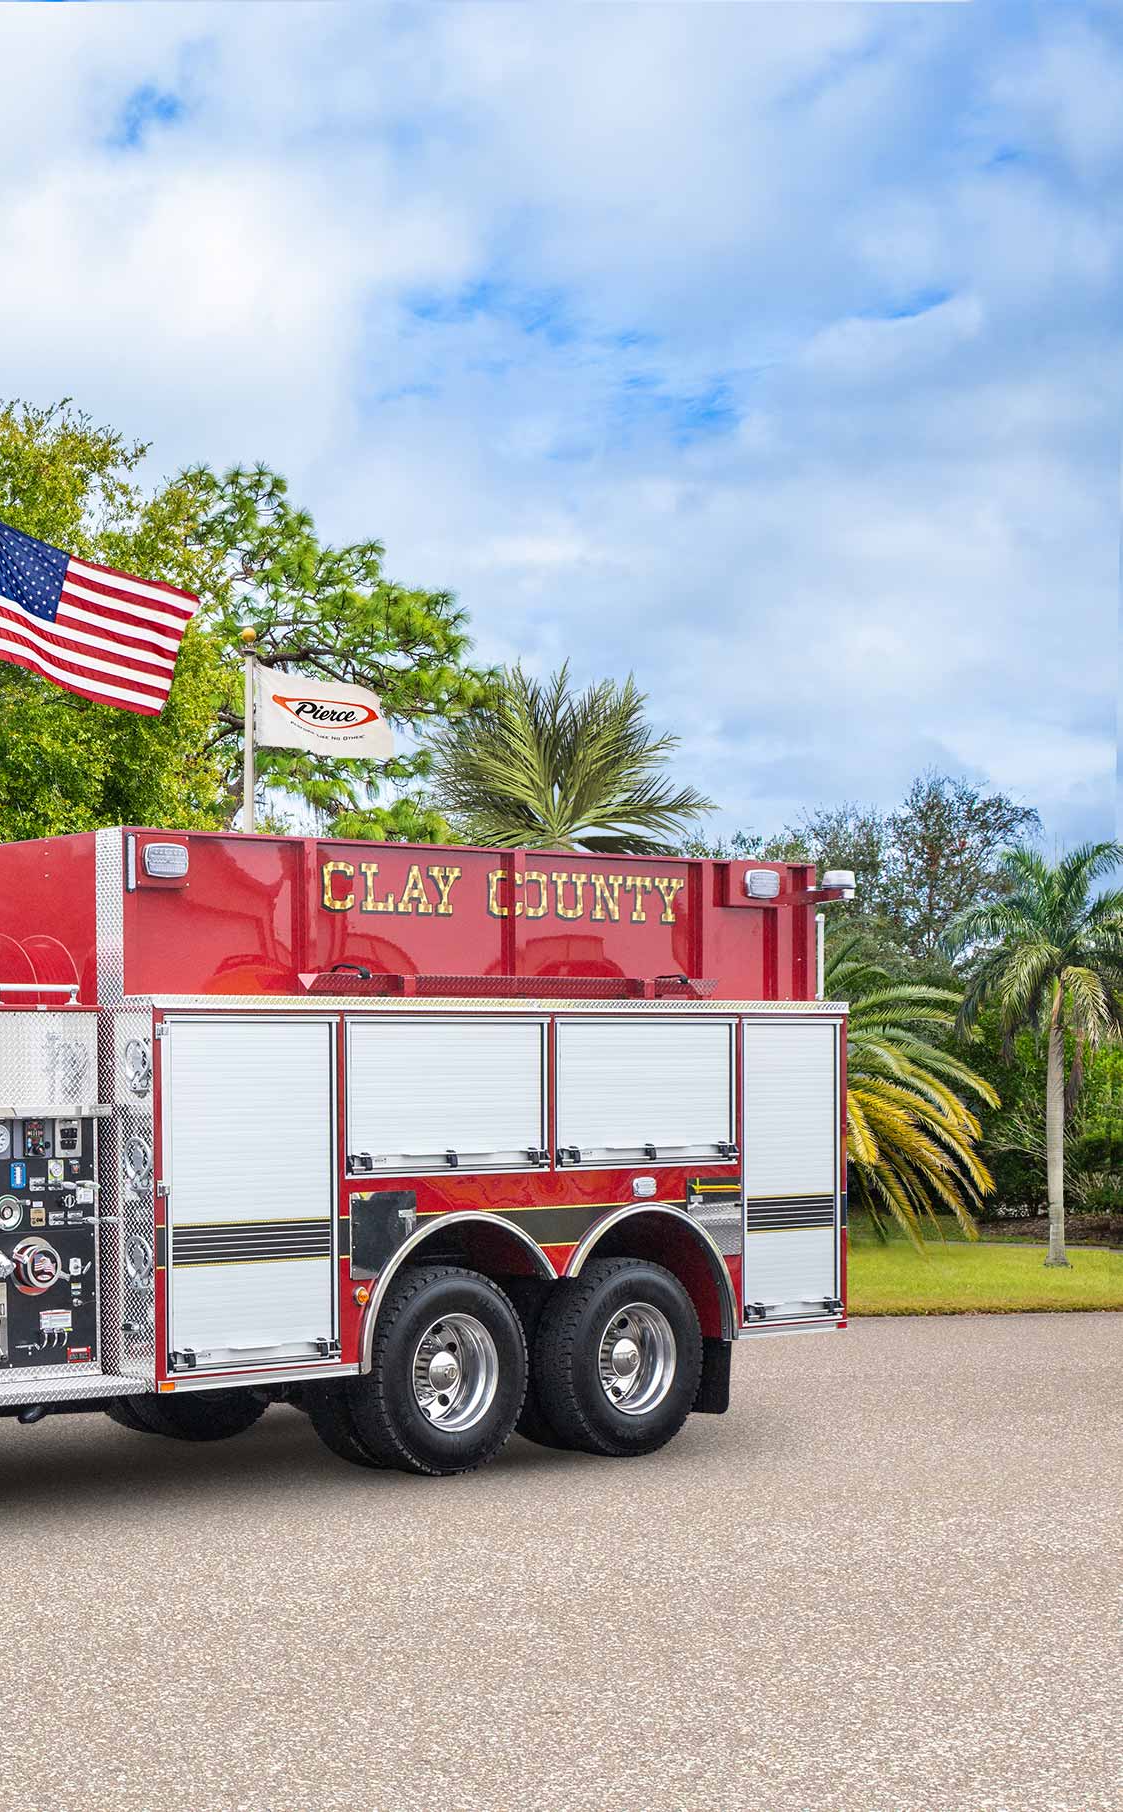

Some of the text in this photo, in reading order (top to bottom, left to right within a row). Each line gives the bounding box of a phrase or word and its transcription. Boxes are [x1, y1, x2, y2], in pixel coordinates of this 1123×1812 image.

[295, 701, 357, 722] Pierce
[321, 861, 685, 925] CLAY COUNTY
